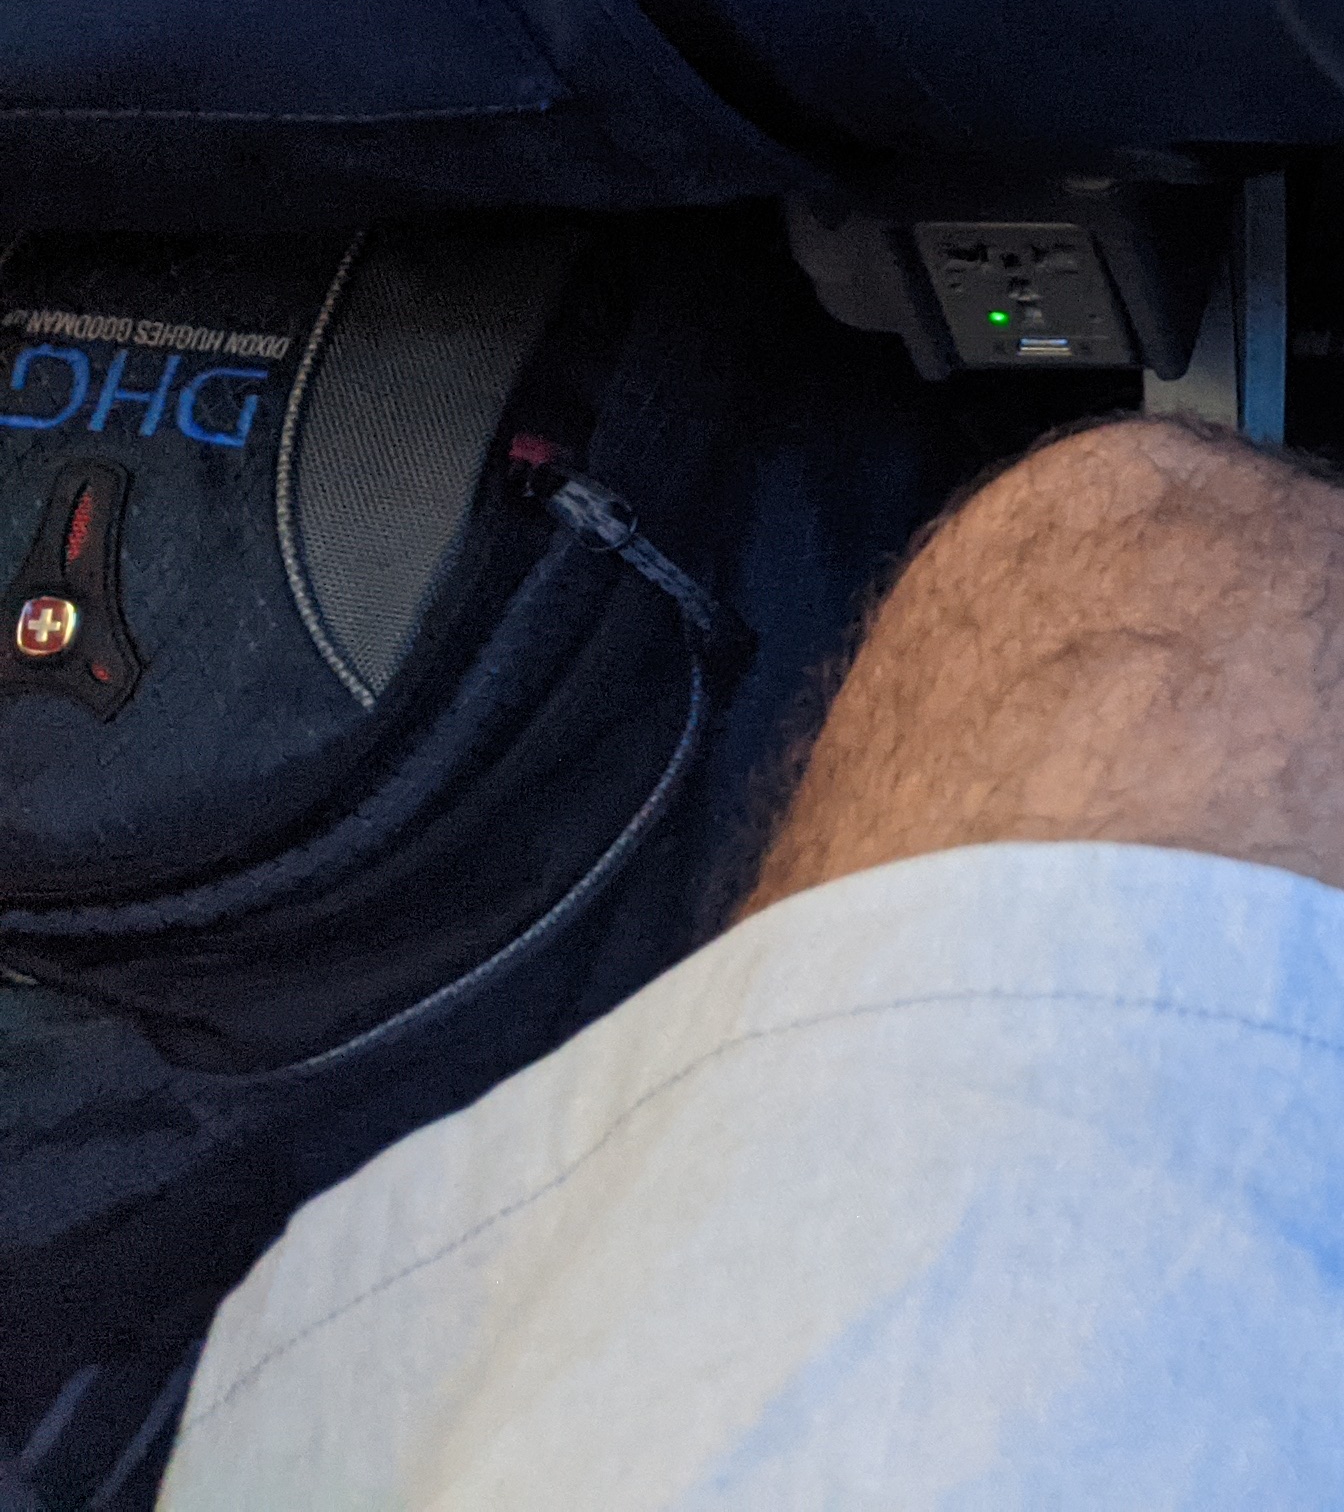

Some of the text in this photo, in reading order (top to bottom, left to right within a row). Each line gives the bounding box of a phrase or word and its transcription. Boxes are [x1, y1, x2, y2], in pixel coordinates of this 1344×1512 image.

[26, 309, 133, 343] GOODMAN
[133, 318, 225, 351] HUGHES
[222, 332, 290, 360] DIXON
[0, 344, 268, 449] DHG
